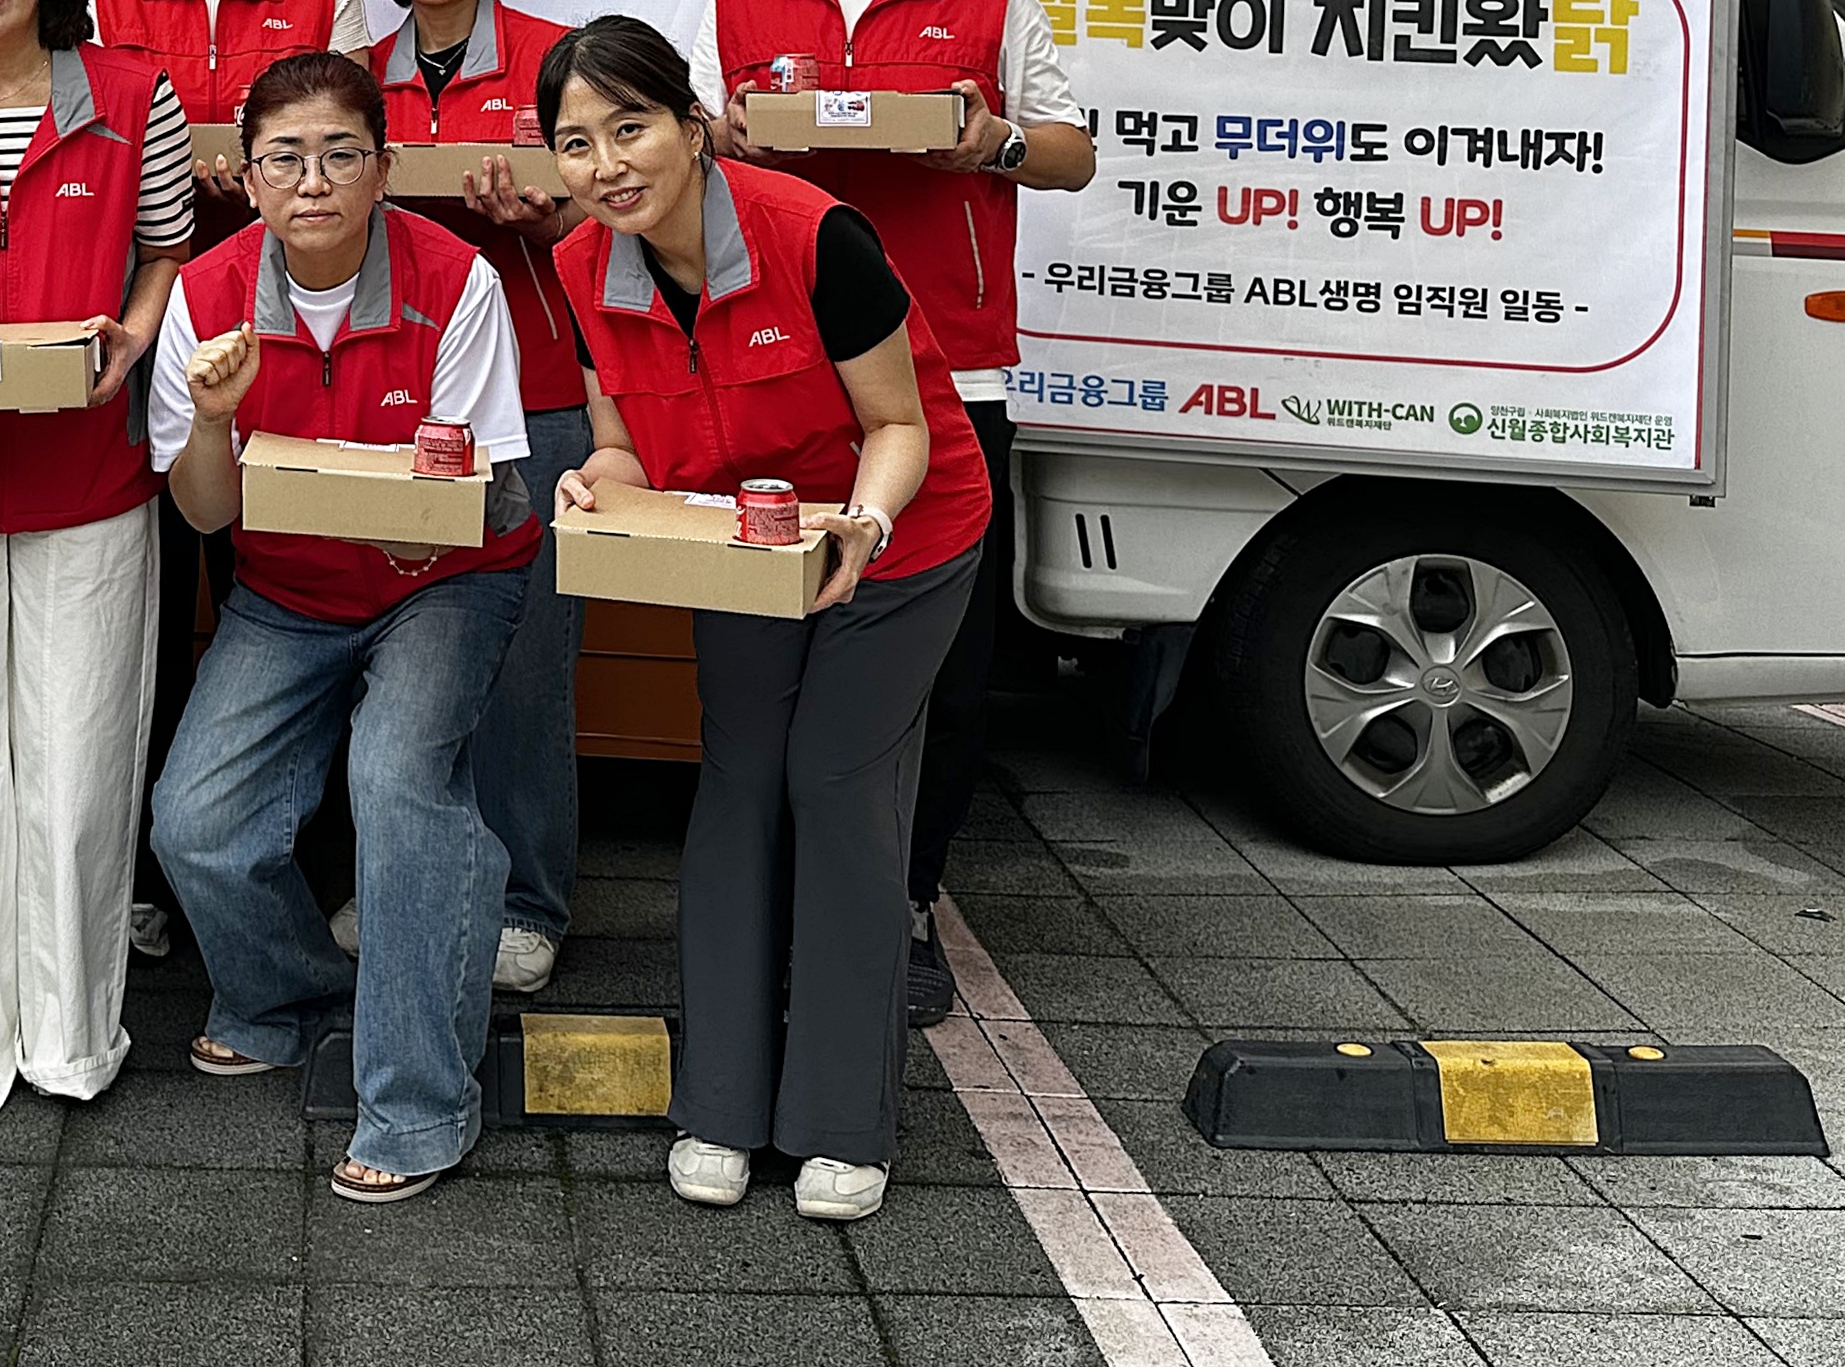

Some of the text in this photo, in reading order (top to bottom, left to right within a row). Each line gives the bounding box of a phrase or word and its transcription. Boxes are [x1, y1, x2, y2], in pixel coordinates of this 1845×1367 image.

[262, 18, 293, 30] ABL
[919, 26, 955, 39] ABL
[480, 100, 513, 112] ABL
[1116, 110, 1199, 157] 먹고
[1214, 115, 1390, 165] 무더위도
[1404, 122, 1604, 175] 이겨내자!
[56, 183, 95, 197] ABL
[1117, 180, 1504, 242] 기운 UP! 행복 UP!
[1044, 262, 1235, 304] 우리금융그룹
[1243, 280, 1382, 317] ABL생명
[1393, 286, 1490, 322] 임직원
[1500, 290, 1565, 325] 일동
[749, 326, 790, 347] ABL
[381, 389, 417, 407] ABL
[1178, 384, 1276, 420] ABL
[1326, 398, 1435, 423] WITH-CAN
[1487, 417, 1675, 451] 신월종합사회복지관
